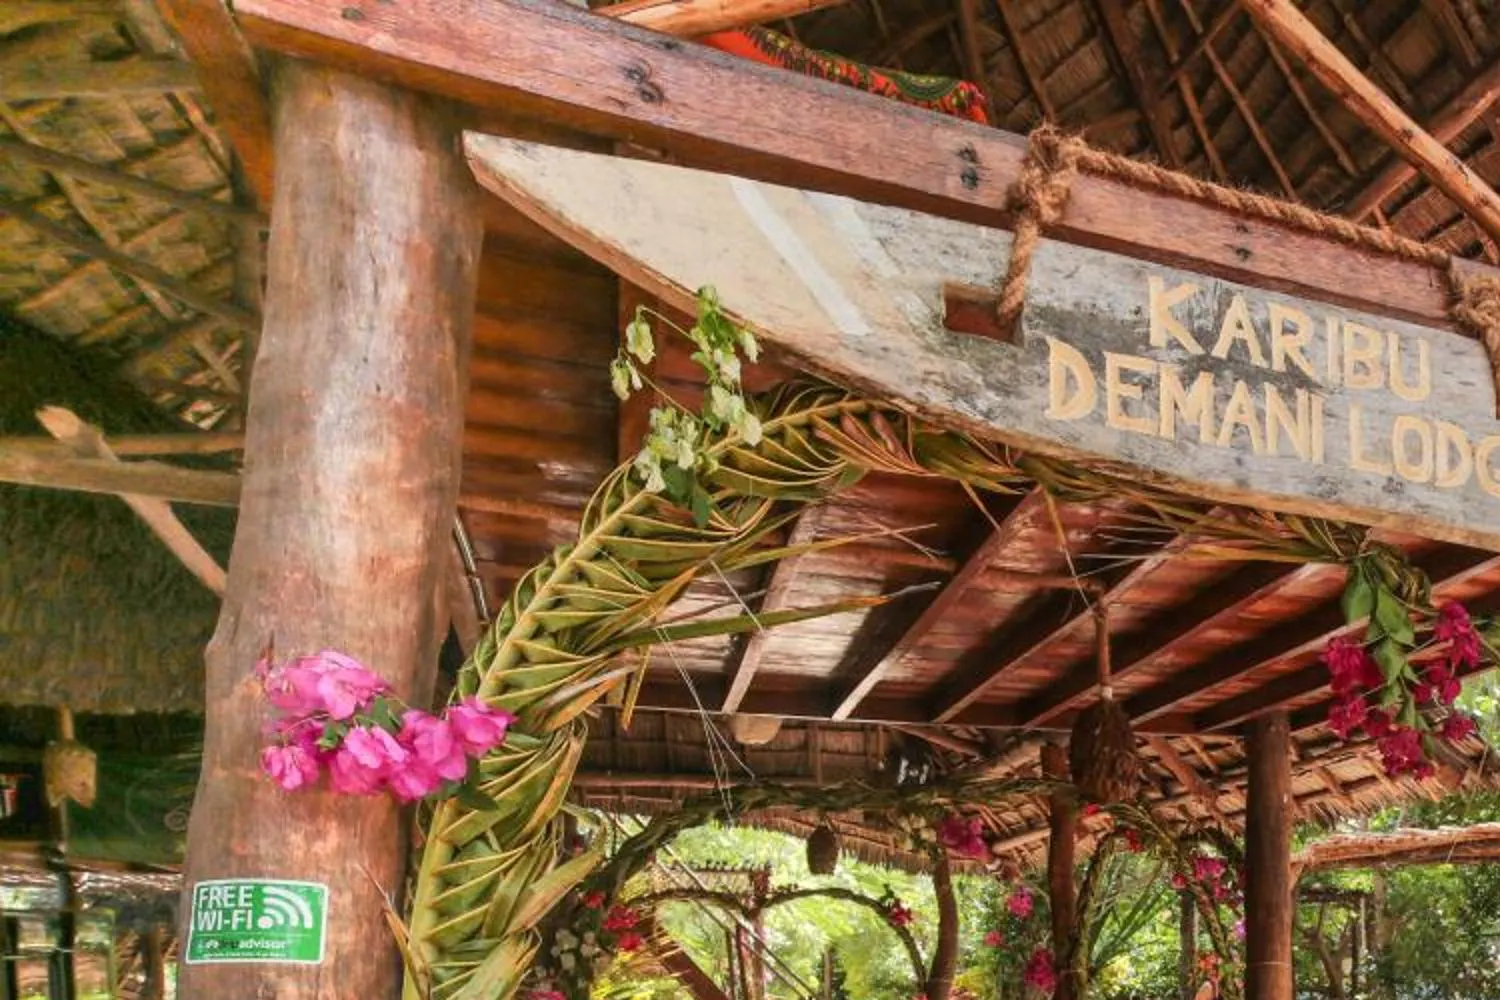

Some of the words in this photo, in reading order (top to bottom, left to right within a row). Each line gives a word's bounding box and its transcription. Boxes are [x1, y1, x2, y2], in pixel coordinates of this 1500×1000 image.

[1148, 275, 1431, 401] KARIBU
[1044, 337, 1325, 464] DEMANI
[198, 909, 253, 931] WI-FI
[199, 885, 254, 909] FREE
